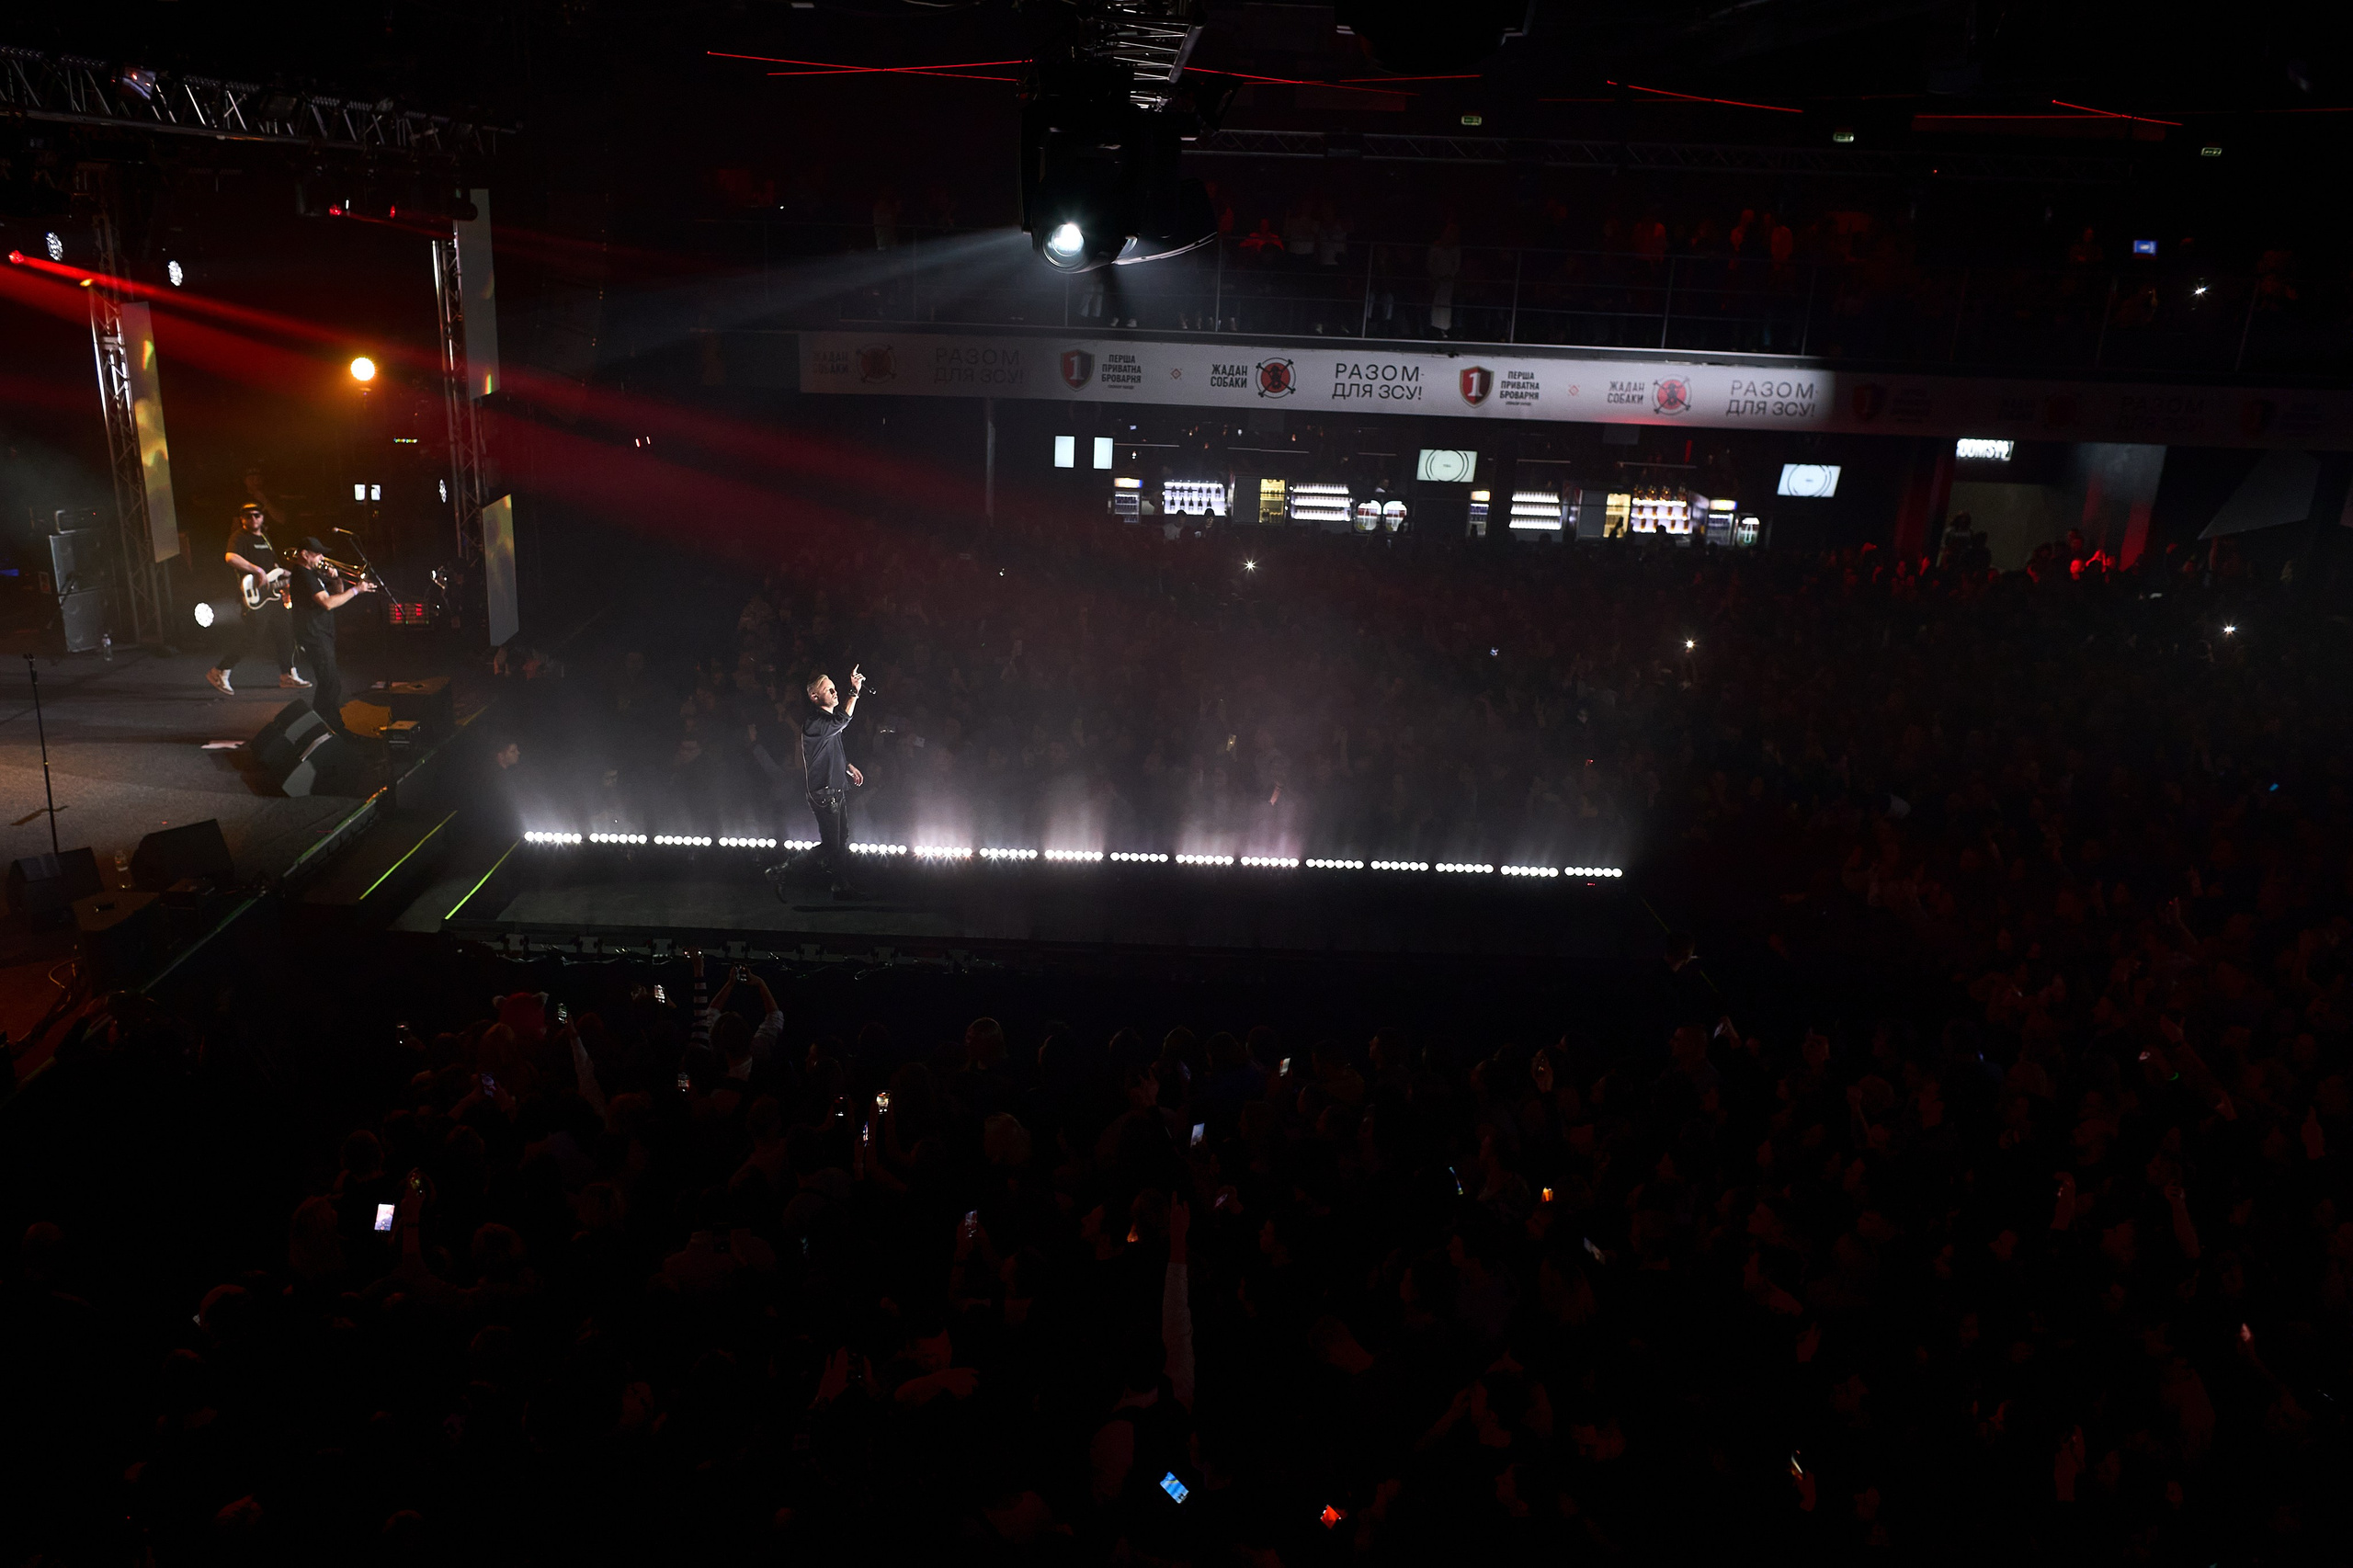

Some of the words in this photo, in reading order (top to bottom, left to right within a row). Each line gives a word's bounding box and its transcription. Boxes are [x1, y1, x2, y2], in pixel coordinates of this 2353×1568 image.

[936, 348, 1019, 365] РАЗОМ
[1108, 355, 1135, 363] ПЕРША
[1102, 364, 1142, 373] ПРИВАТНА
[1211, 364, 1248, 377] ЖАДАН
[1336, 363, 1419, 381] РАЗОМ
[934, 368, 974, 383] ДЛЯ
[980, 369, 1024, 384] ЗСУ!
[1101, 374, 1142, 383] БРОВАРНЯ
[1508, 371, 1535, 380] ПЕРША
[1211, 376, 1247, 388] СОБАКИ
[1501, 381, 1540, 390] ПРИВАТНА
[1608, 381, 1645, 392] ЖАДАН
[1332, 382, 1373, 400] ДЛЯ
[1379, 384, 1422, 400] ЗСУ!
[1500, 391, 1540, 400] БРОВАРНЯ
[1731, 380, 1814, 399] РАЗОМ
[1608, 392, 1644, 404] СОБАКИ
[1726, 399, 1768, 416] ДЛЯ
[1772, 401, 1816, 417] ЗСУ!
